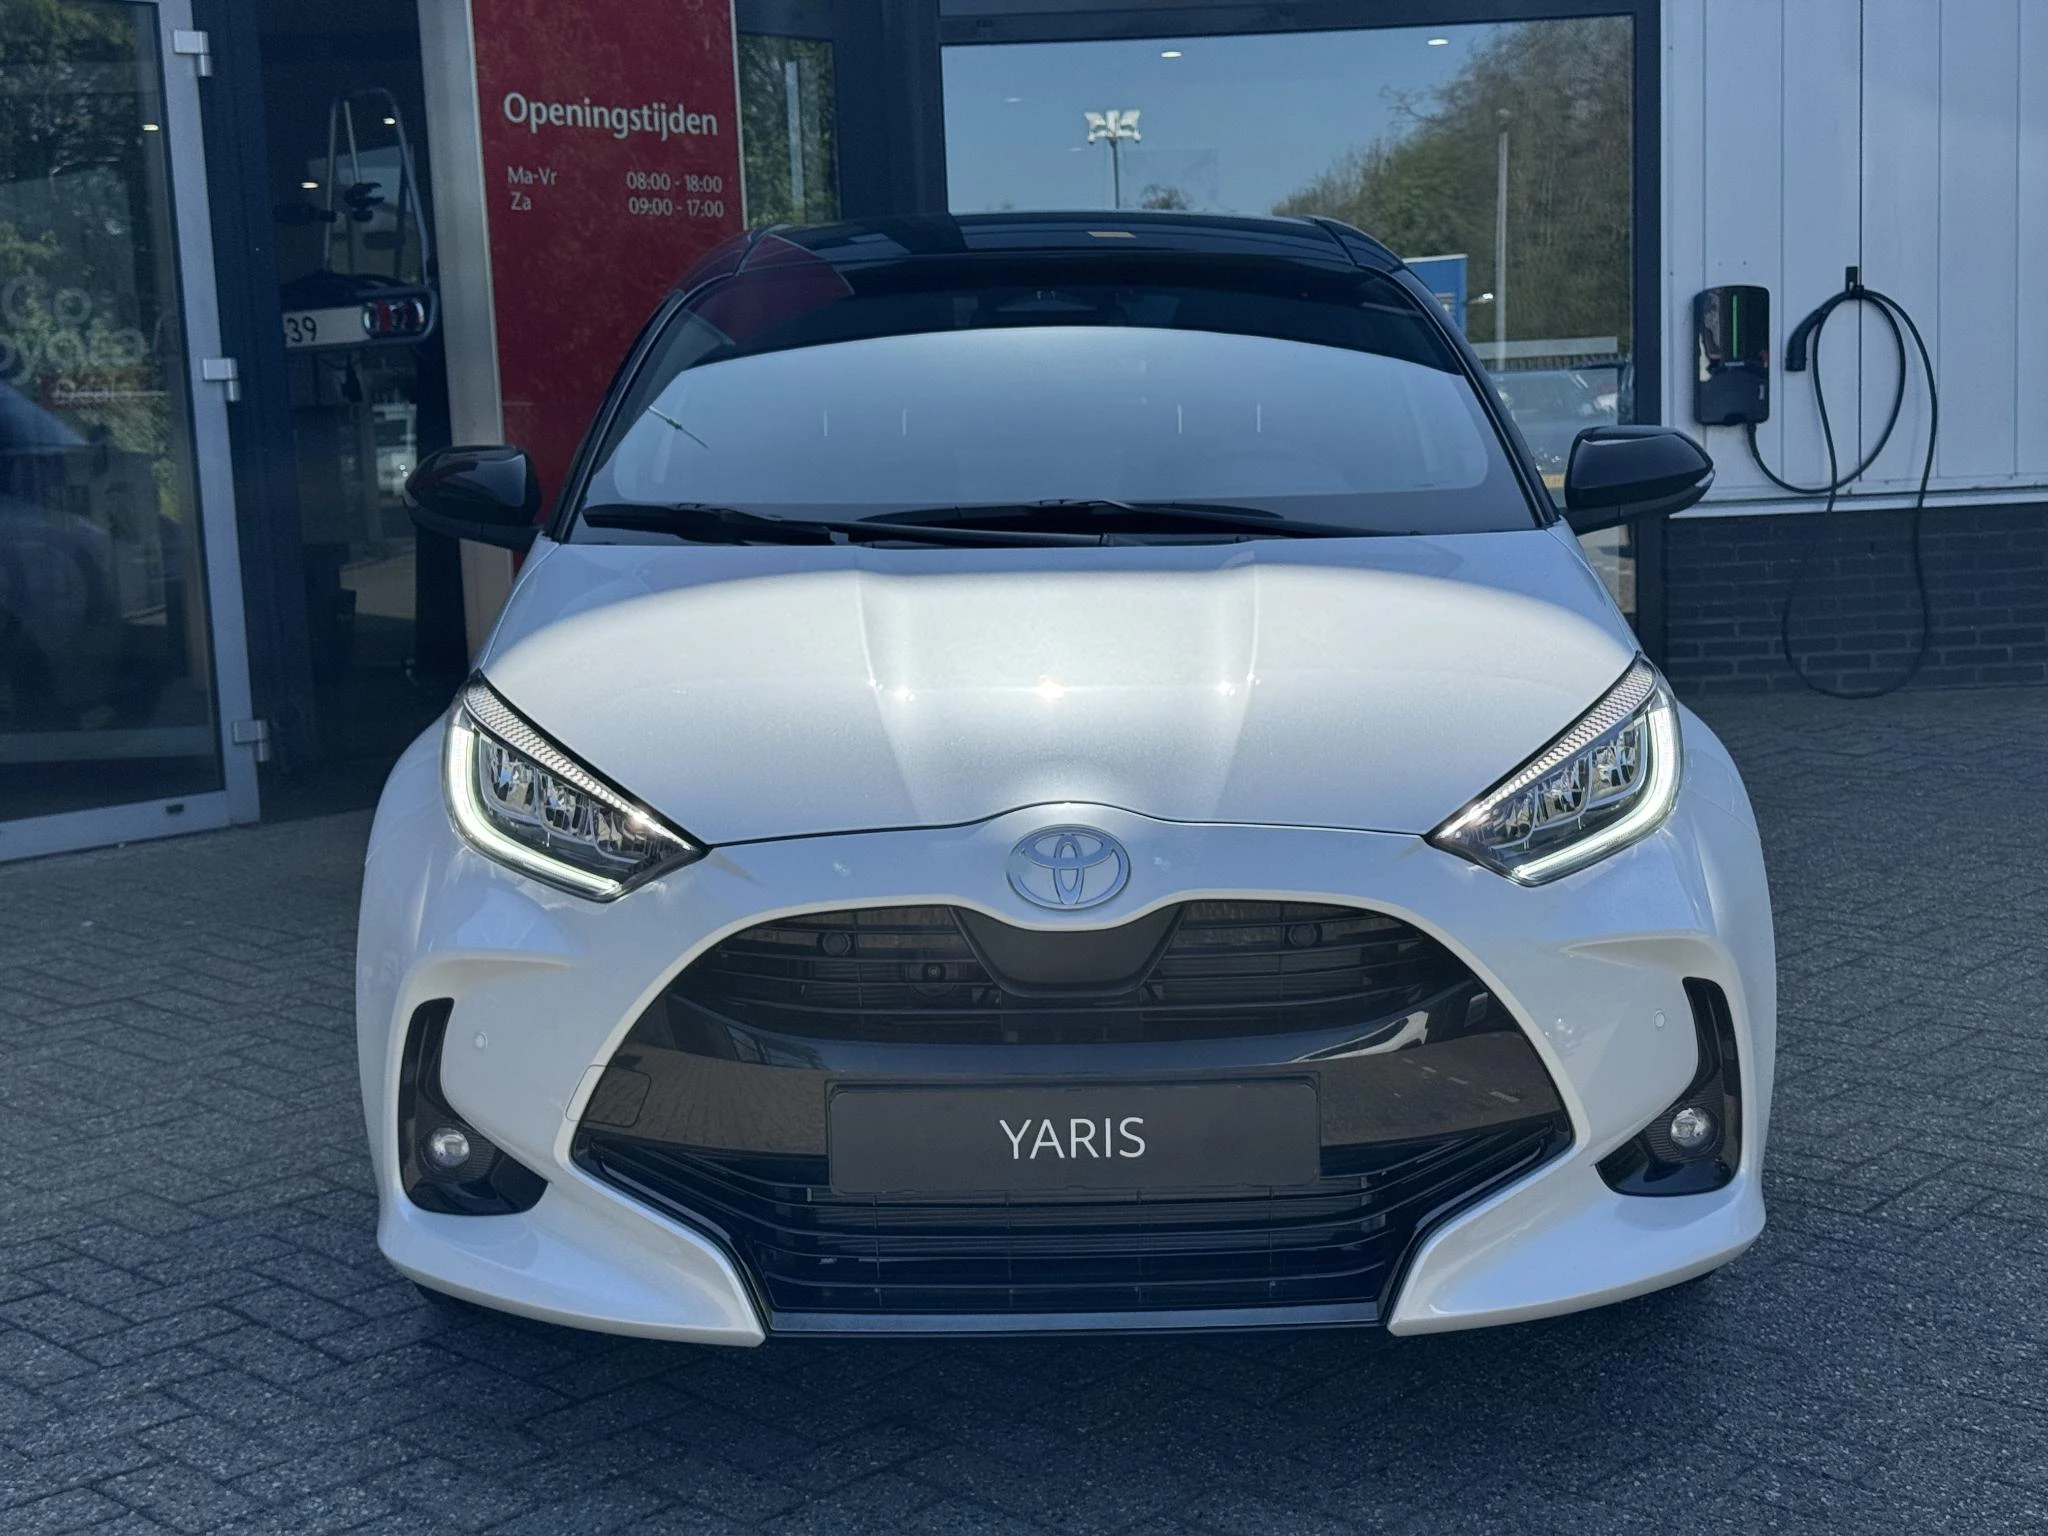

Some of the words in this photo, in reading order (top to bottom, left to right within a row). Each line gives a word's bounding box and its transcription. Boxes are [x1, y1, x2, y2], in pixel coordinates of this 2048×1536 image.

[503, 92, 718, 142] Openingstijden
[507, 165, 557, 186] Ma-Vr
[626, 171, 671, 191] 08:00
[685, 173, 722, 193] 18:00
[511, 192, 532, 211] Za
[628, 196, 673, 216] 09:00
[686, 199, 724, 218] 17:00
[1000, 1116, 1146, 1160] YARIS
